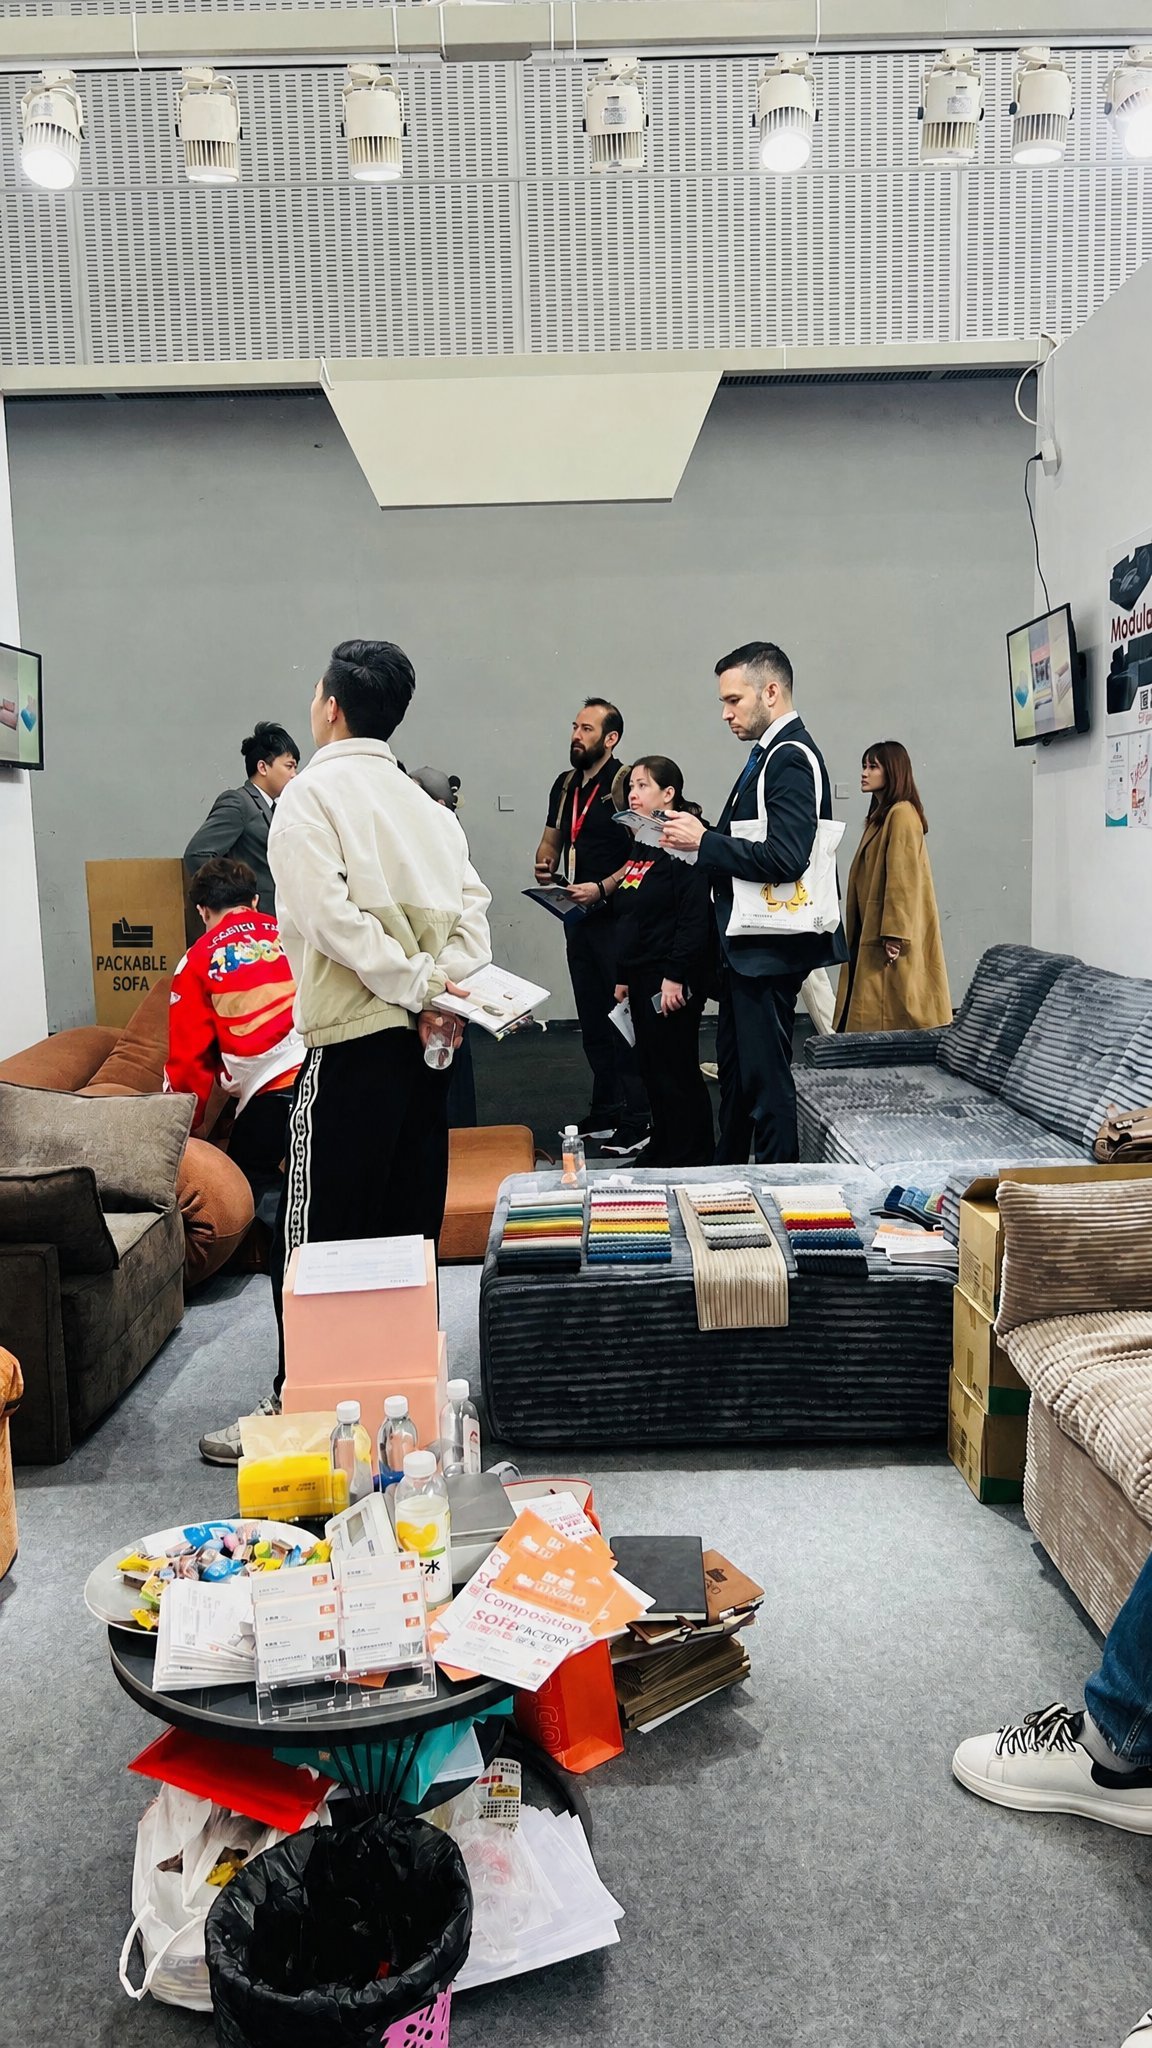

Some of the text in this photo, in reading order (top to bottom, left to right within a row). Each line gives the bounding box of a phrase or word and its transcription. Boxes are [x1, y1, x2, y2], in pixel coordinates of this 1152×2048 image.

[96, 955, 167, 971] PACKABLE
[113, 976, 150, 991] SOFA
[484, 1590, 582, 1633] Composition
